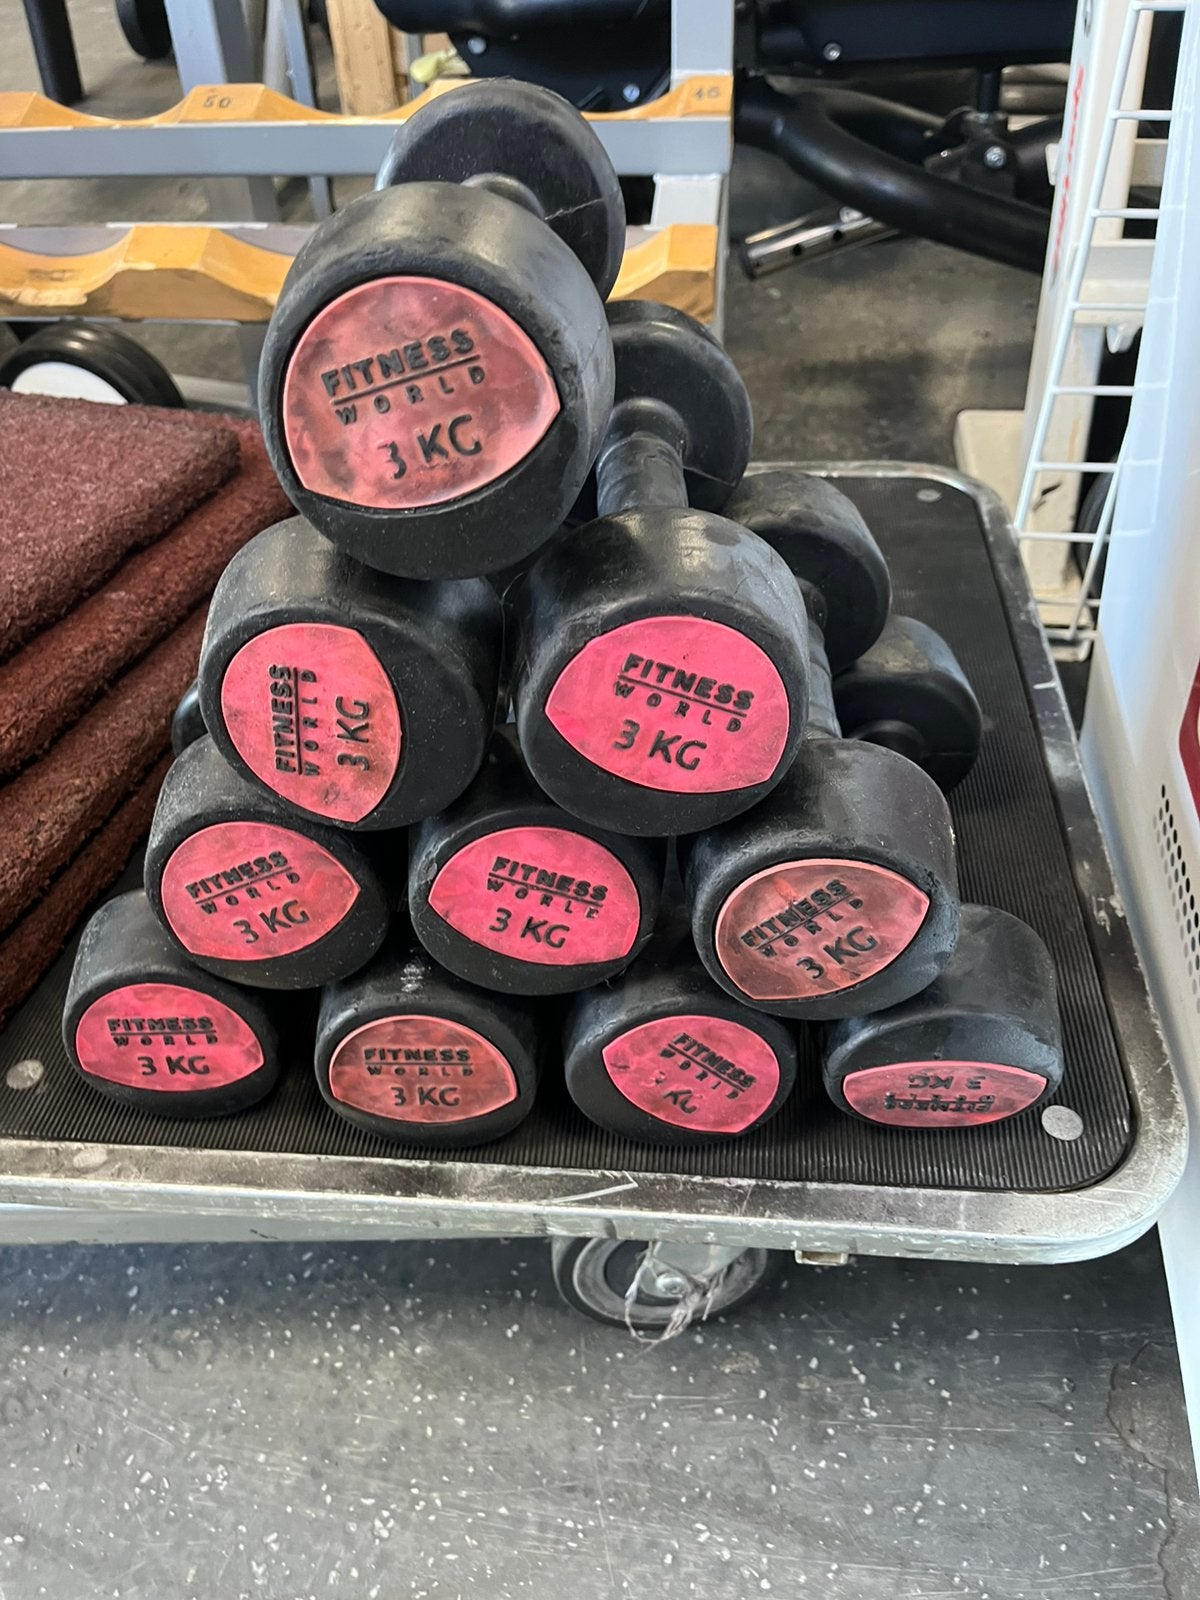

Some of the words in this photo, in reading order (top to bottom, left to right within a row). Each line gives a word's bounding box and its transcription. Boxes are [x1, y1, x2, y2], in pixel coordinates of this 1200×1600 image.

[320, 328, 475, 397] FITNESS
[334, 365, 486, 426] WORLD
[377, 440, 408, 480] 3
[416, 413, 483, 464] KG
[621, 652, 755, 711] FITNESS
[268, 664, 296, 773] FITNESS
[300, 669, 320, 777] WORLD
[335, 696, 370, 744] KG
[613, 680, 742, 733] WORLD
[336, 752, 370, 771] 3
[612, 719, 641, 750] 3
[648, 729, 708, 771] KG
[185, 850, 289, 899] FITNESS
[200, 872, 301, 915] WORLD
[491, 855, 609, 902] FITNESS
[232, 919, 260, 944] 3
[258, 899, 310, 934] KG
[488, 907, 513, 933] 3
[520, 915, 571, 949] KG
[740, 879, 848, 948] FITNESS
[761, 897, 864, 958] WORLD
[796, 956, 825, 980] 3
[822, 925, 879, 965] KG
[106, 1017, 215, 1032] FITNESS
[112, 1035, 219, 1048] WORLD
[137, 1055, 158, 1076] 3
[165, 1055, 211, 1075] KG
[363, 1047, 471, 1062] FITNESS
[366, 1065, 474, 1077] WORLD
[673, 1032, 757, 1089] FITNESS
[390, 1086, 407, 1107] 3
[416, 1086, 460, 1107] KG
[907, 1072, 954, 1090] KG
[966, 1075, 986, 1090] 3
